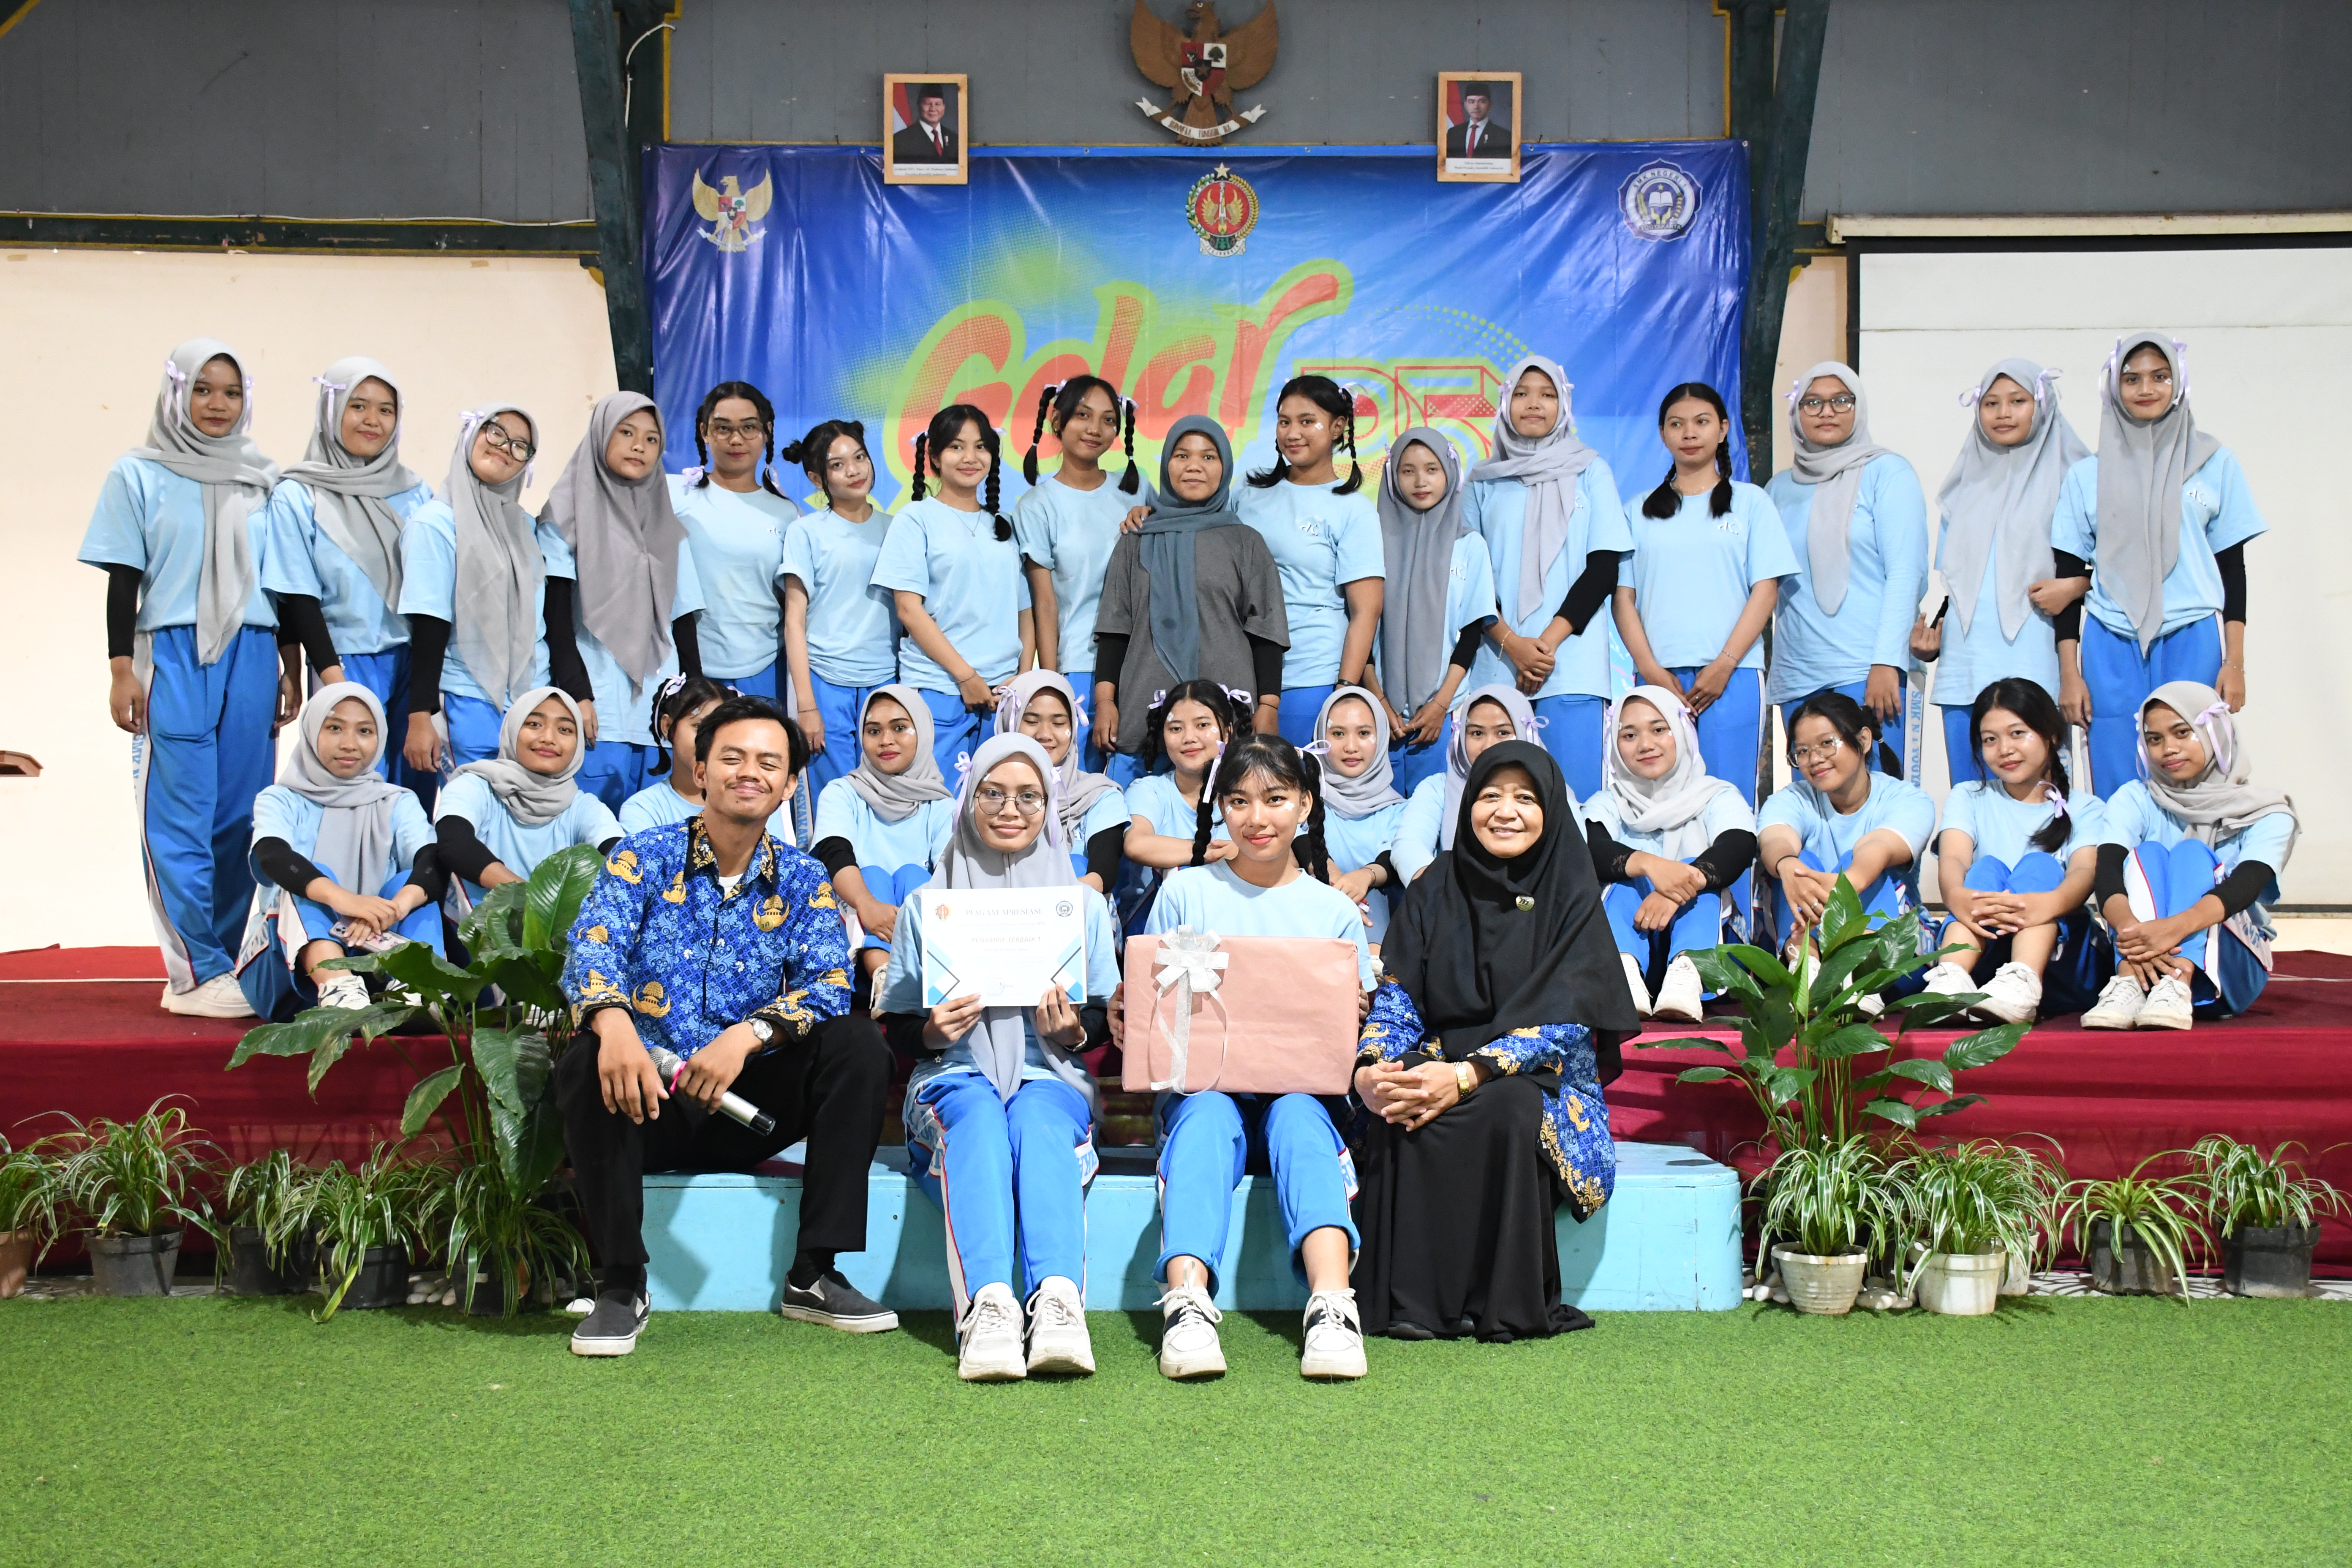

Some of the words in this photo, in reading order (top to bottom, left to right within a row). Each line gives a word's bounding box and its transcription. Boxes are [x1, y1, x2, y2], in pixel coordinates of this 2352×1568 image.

[1633, 175, 1648, 188] SMK
[1651, 171, 1682, 183] NEGERI
[1911, 691, 1922, 720] SMK
[1912, 724, 1919, 732] N
